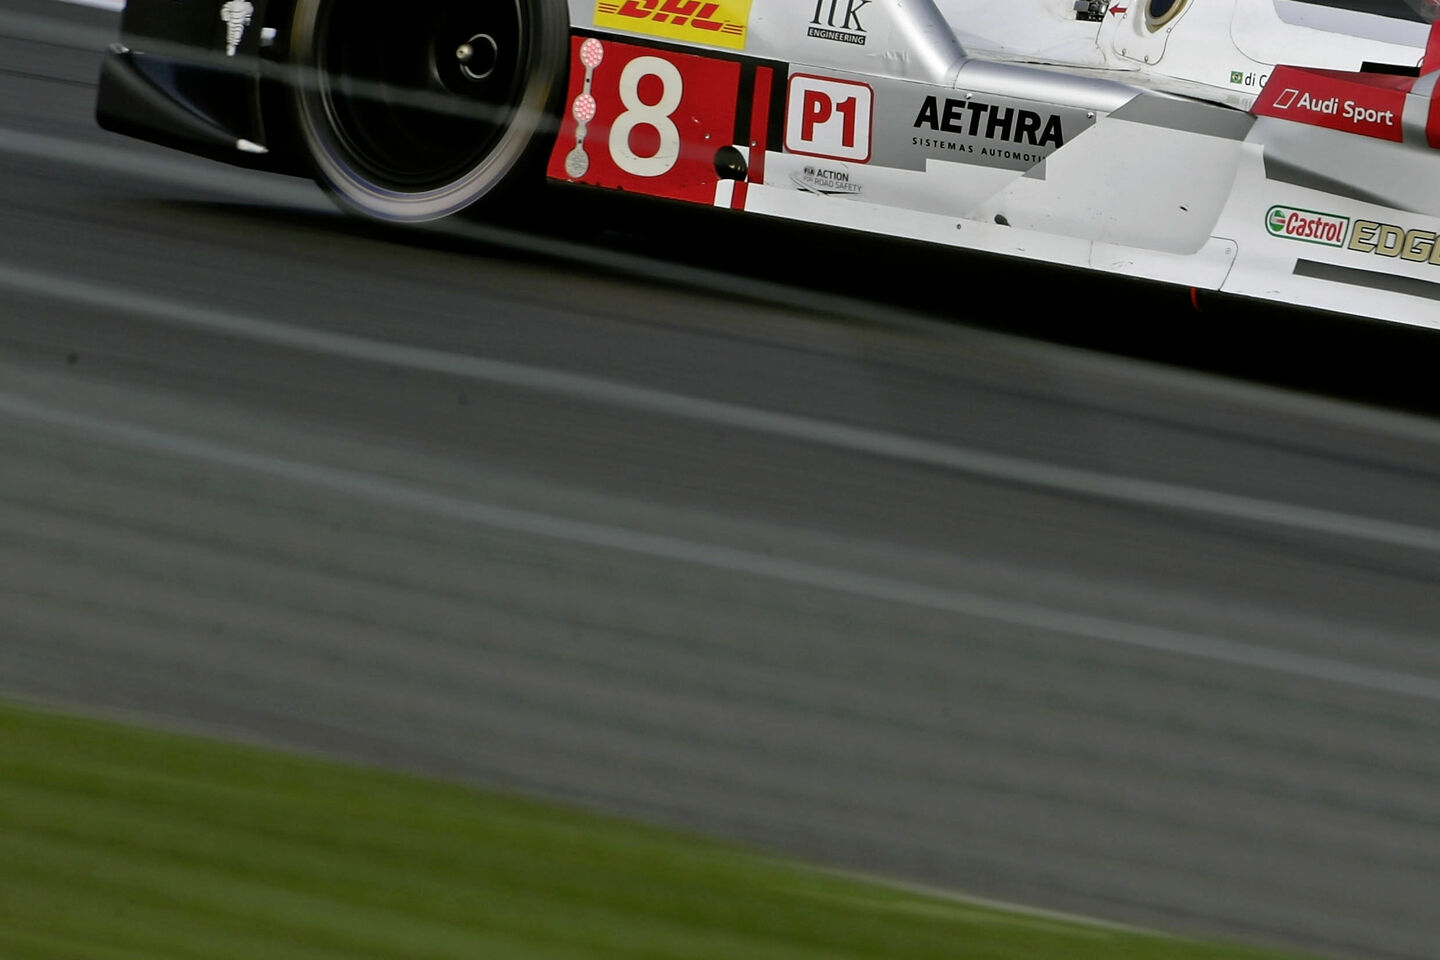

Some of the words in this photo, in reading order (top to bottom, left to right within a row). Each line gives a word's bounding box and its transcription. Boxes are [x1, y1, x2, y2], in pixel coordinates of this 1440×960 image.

[808, 27, 865, 45] ENGINEERING
[1244, 71, 1256, 87] di
[608, 56, 684, 177] 8
[800, 90, 857, 148] P1
[1297, 92, 1339, 115] Audi
[1342, 100, 1395, 126] Sport
[913, 95, 1065, 149] AETHRA
[912, 136, 974, 154] SISTEMAS
[814, 177, 834, 188] ROAD
[835, 180, 862, 192] SAFETY
[816, 168, 849, 182] ACTION
[1286, 212, 1344, 243] Castrol
